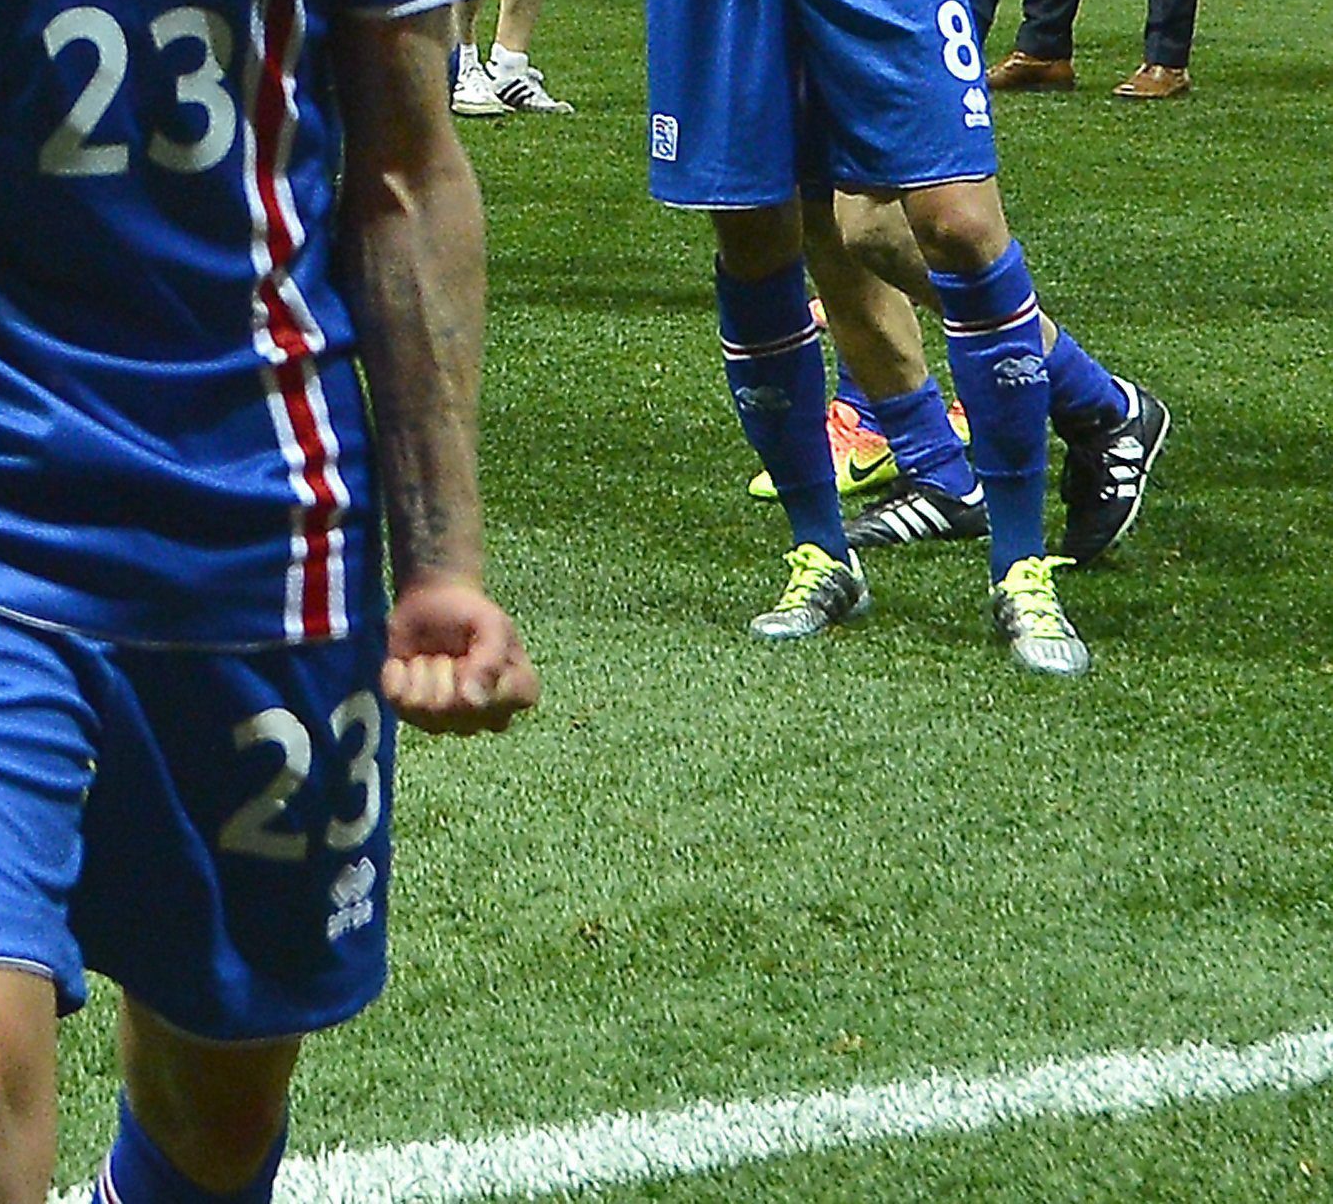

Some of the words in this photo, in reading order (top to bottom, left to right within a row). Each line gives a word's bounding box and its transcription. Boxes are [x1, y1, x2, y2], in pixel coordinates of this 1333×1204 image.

[37, 5, 237, 177] 23
[936, 0, 982, 82] 8
[220, 691, 382, 863] 23
